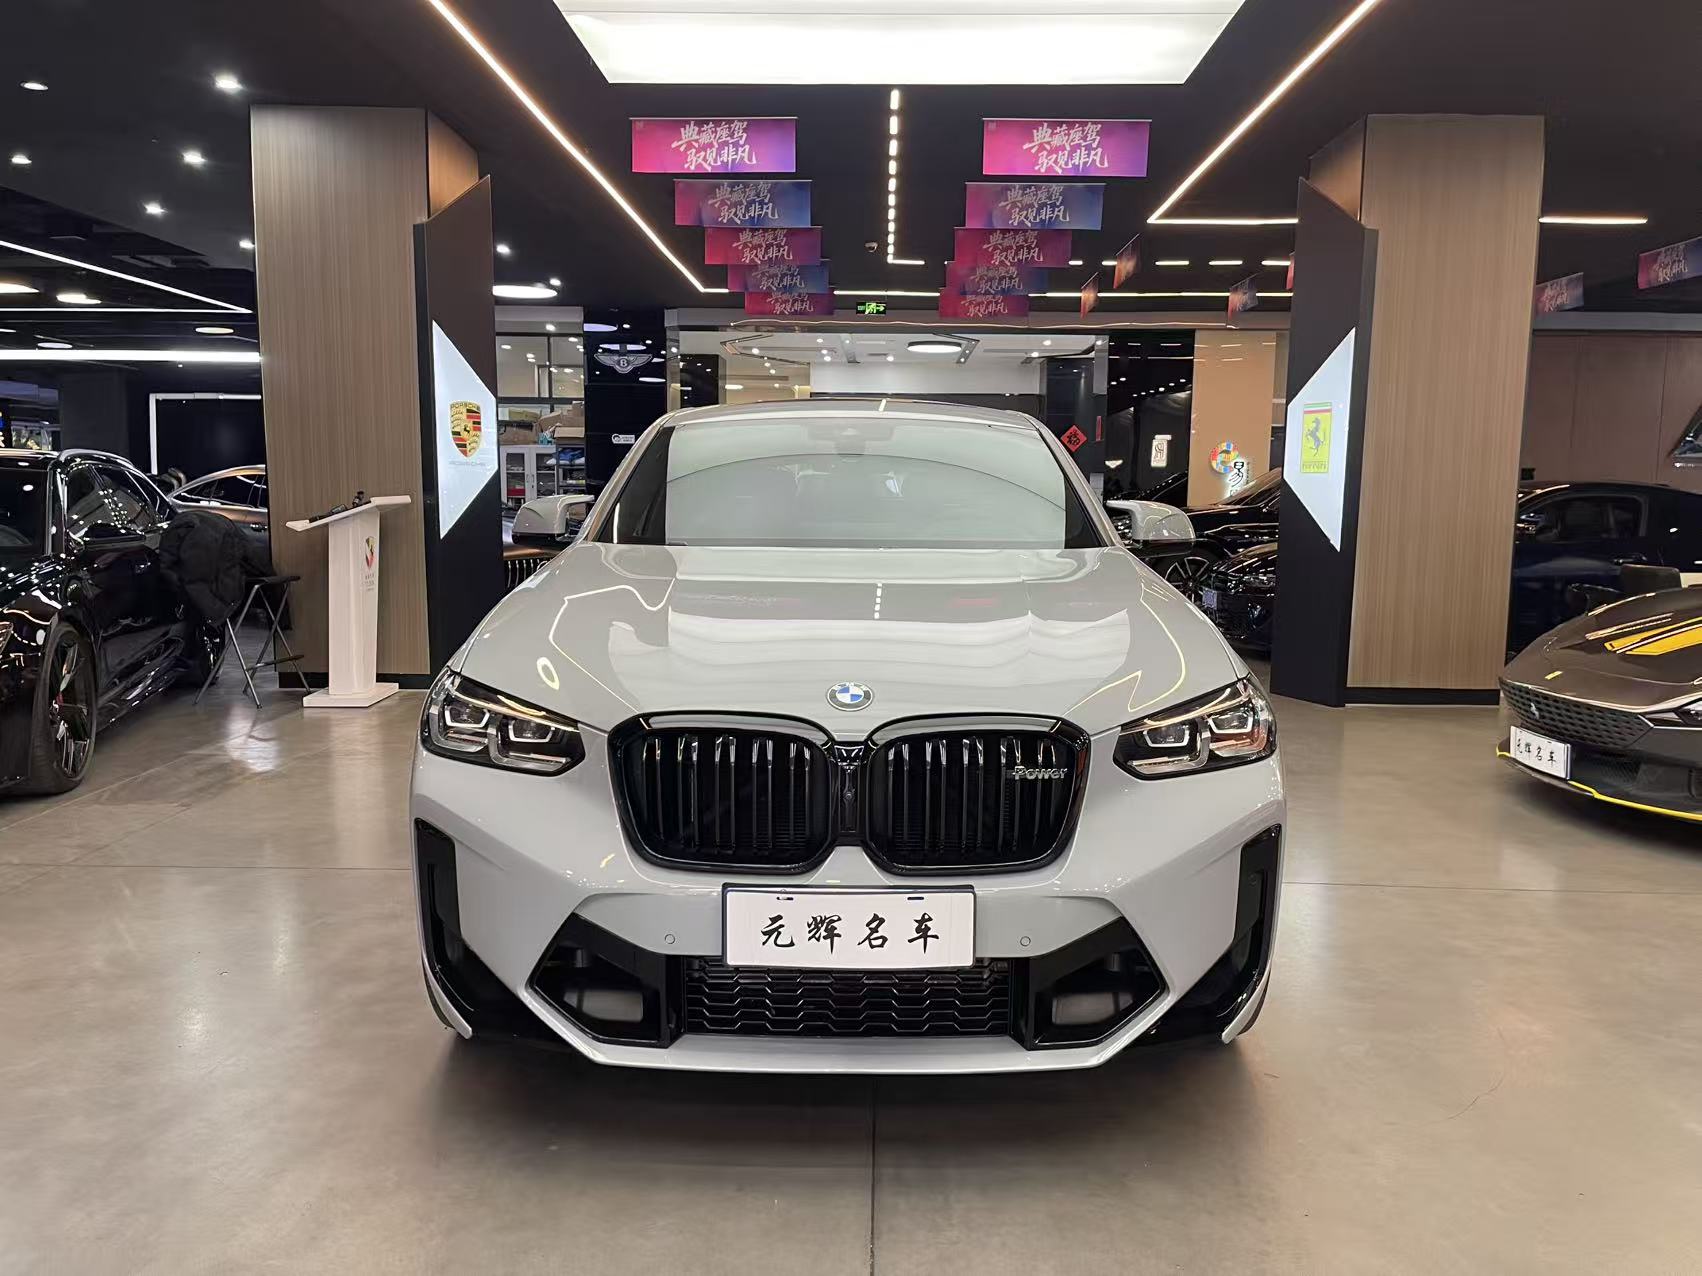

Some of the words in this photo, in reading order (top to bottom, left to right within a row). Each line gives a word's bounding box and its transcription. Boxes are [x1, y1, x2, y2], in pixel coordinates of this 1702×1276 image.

[671, 120, 748, 152] 典藏座驾
[1023, 122, 1102, 152] 典藏座驾
[684, 143, 757, 172] 驭见非凡
[1035, 147, 1108, 174] 驭见非凡
[709, 181, 772, 206] 典藏座驾
[999, 183, 1064, 210] 典藏座驾
[718, 202, 778, 225] 驭见非凡
[1008, 205, 1069, 227] 驭见非凡
[760, 912, 940, 955] 元辉名车
